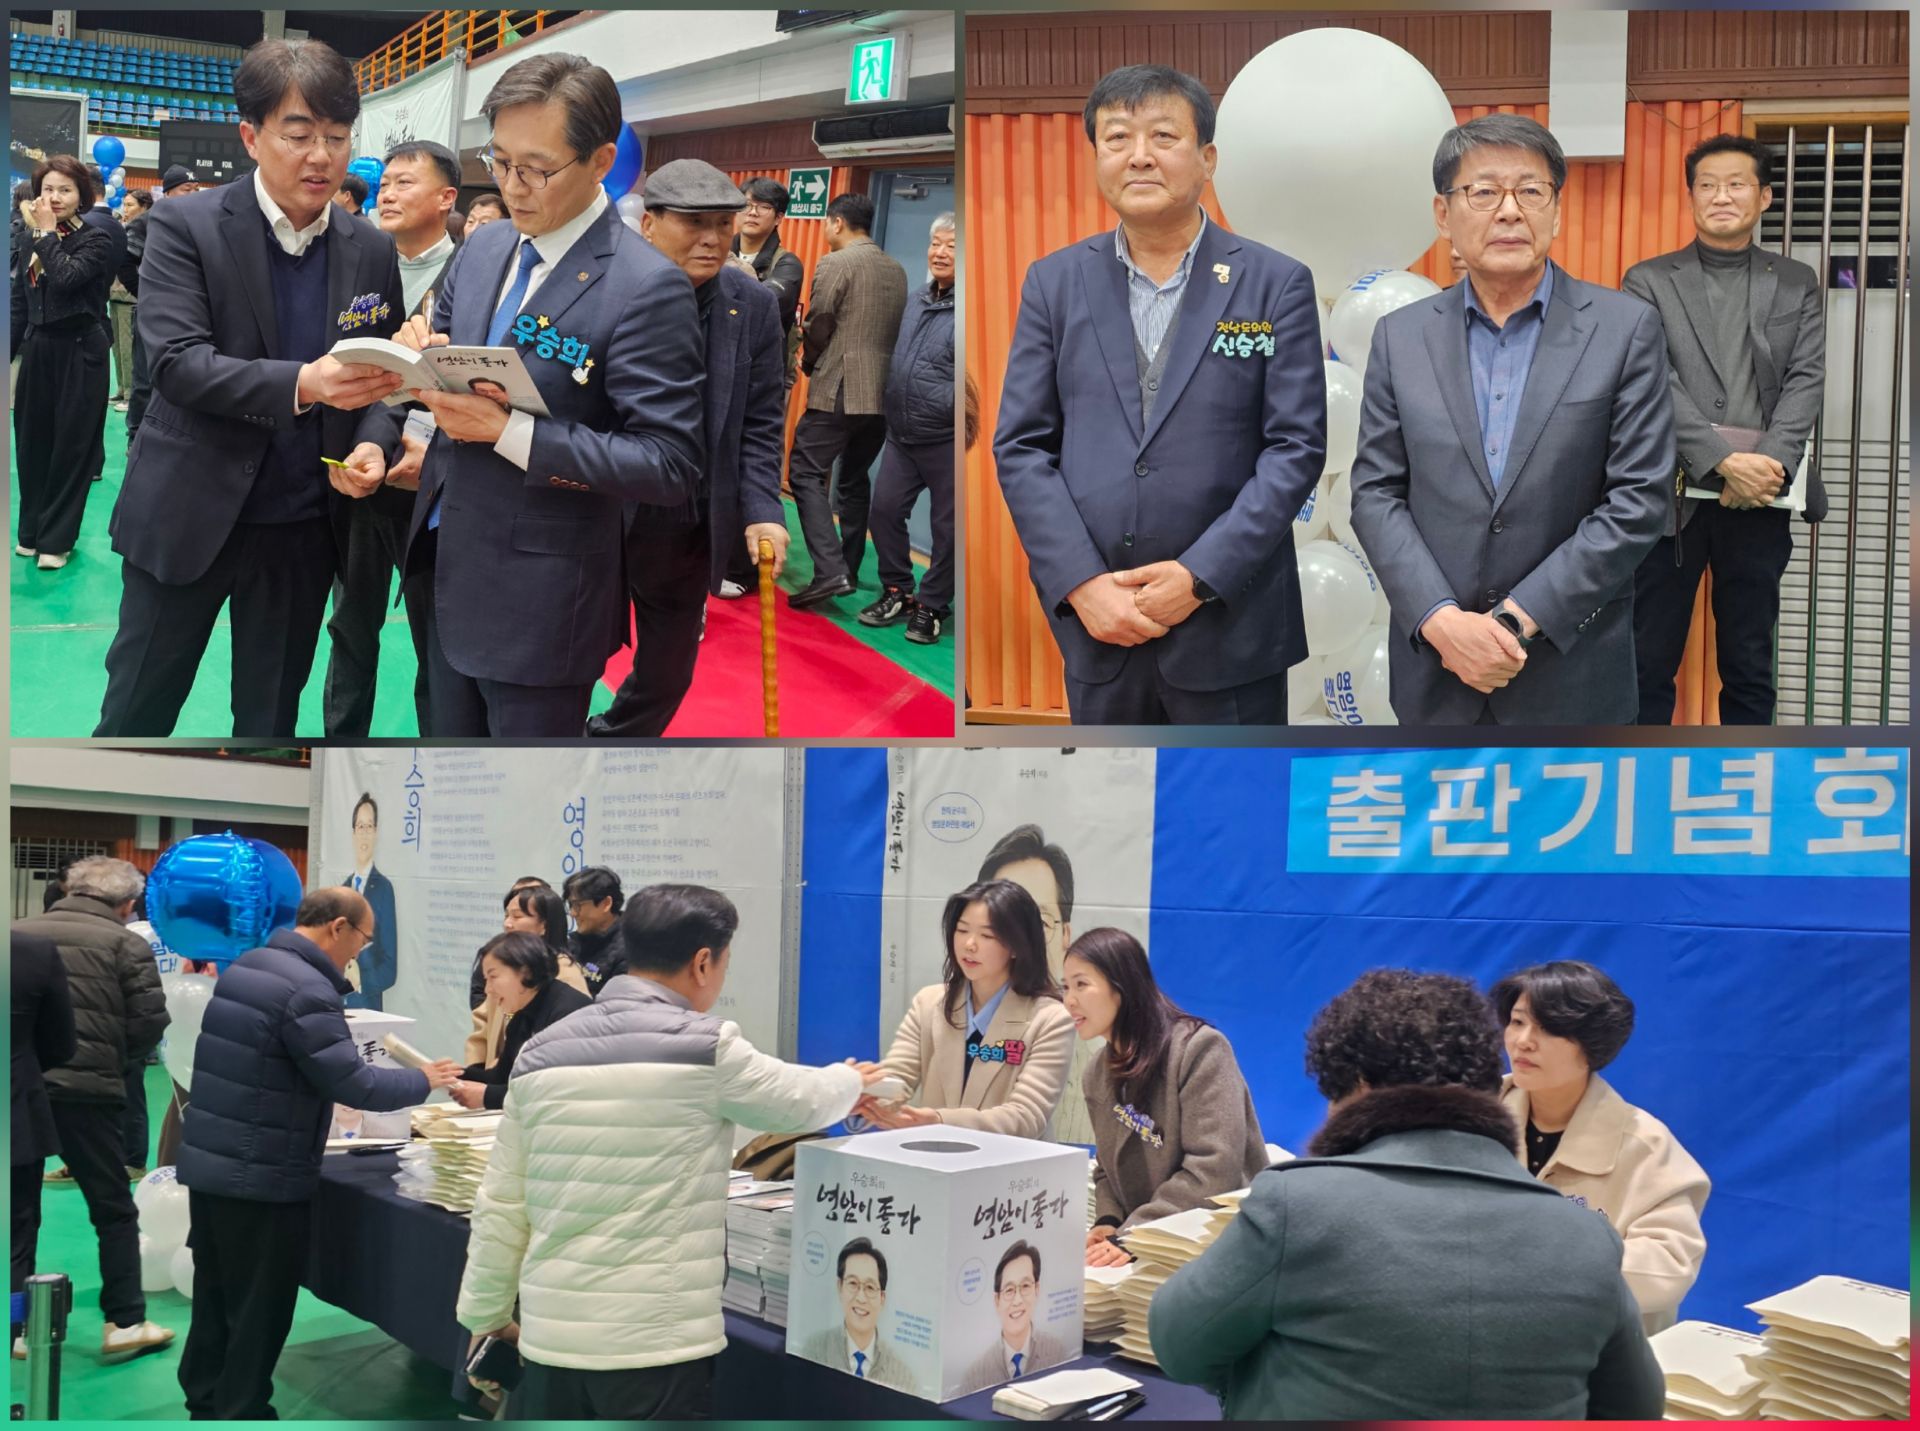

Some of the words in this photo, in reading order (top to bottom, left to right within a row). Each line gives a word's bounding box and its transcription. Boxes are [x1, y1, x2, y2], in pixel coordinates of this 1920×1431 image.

[810, 203, 823, 214] 출구
[511, 314, 592, 368] 우승희
[1212, 332, 1276, 358] 신승철
[1216, 320, 1273, 334] 전남도의원
[401, 748, 425, 853] 승희
[817, 1182, 873, 1223] 영암이
[875, 1195, 921, 1235] 좋다
[973, 1197, 1029, 1241] 영암이
[1031, 1189, 1069, 1229] 좋다
